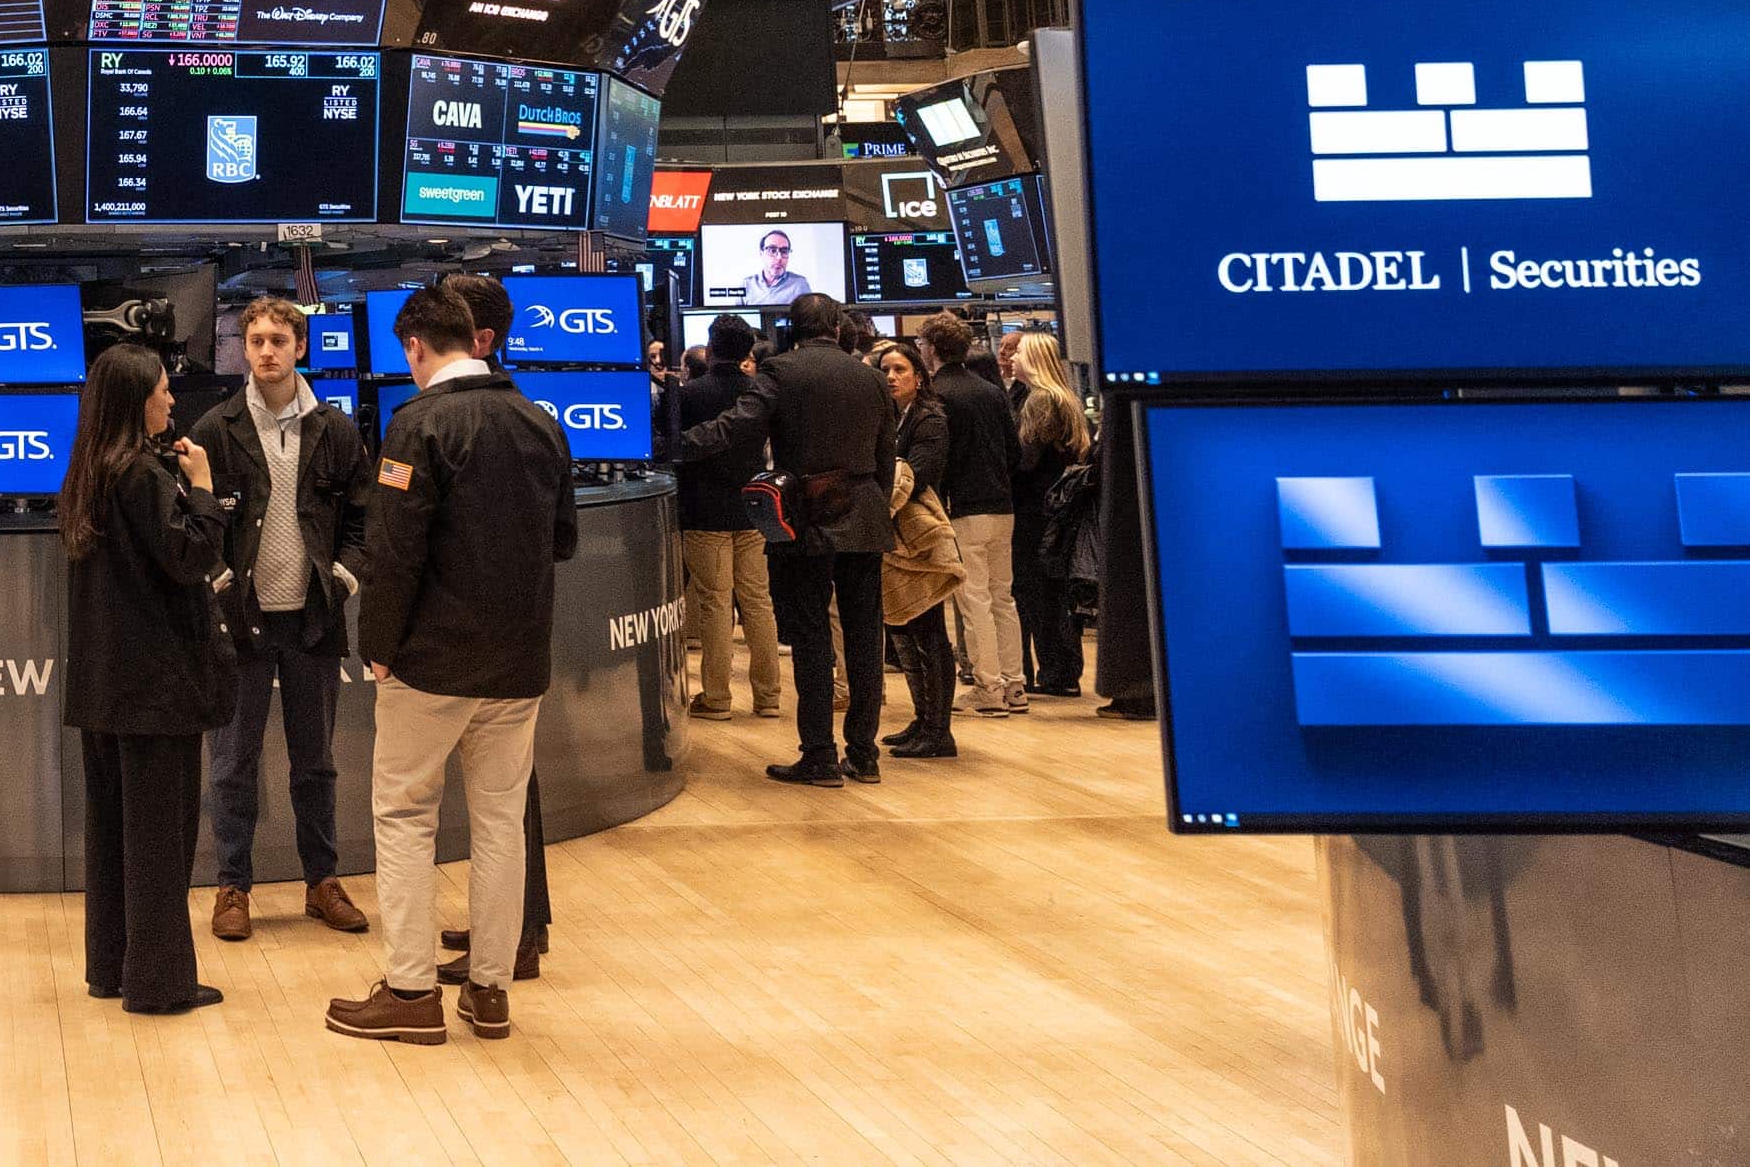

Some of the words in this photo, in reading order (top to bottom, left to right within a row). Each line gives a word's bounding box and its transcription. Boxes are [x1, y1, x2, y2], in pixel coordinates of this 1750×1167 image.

[256, 11, 270, 20] The
[292, 7, 329, 25] Disney
[329, 13, 364, 23] Company
[1, 52, 44, 67] 166.02
[101, 53, 123, 68] RY
[177, 54, 232, 67] 166.0000
[265, 55, 305, 69] 165.92
[335, 56, 375, 69] 166.02
[27, 64, 44, 75] 200
[288, 67, 305, 77] 400
[359, 67, 375, 77] 200
[0, 84, 18, 96] RY
[119, 83, 148, 94] 33,790
[332, 85, 349, 97] RY
[323, 99, 357, 107] LISTED
[119, 106, 148, 116] 166.64
[323, 108, 357, 119] NYSE
[433, 100, 482, 129] CAVA
[118, 130, 147, 140] 167.67
[118, 154, 147, 164] 165.94
[212, 162, 251, 177] RBC
[117, 178, 147, 187] 166.34
[419, 185, 485, 203] sweetgreen
[515, 184, 575, 215] YETI
[714, 192, 735, 202] NEW
[736, 192, 760, 201] YORK
[762, 191, 790, 200] STOCK
[792, 189, 839, 199] EXCHANGE
[94, 202, 146, 212] 1,400,211,000
[286, 225, 314, 236] 1632
[1217, 251, 1440, 294] CITADEL
[1490, 248, 1701, 290] Securities
[508, 337, 525, 346] 9:48
[609, 610, 649, 651] NEW
[650, 599, 679, 639] YORK
